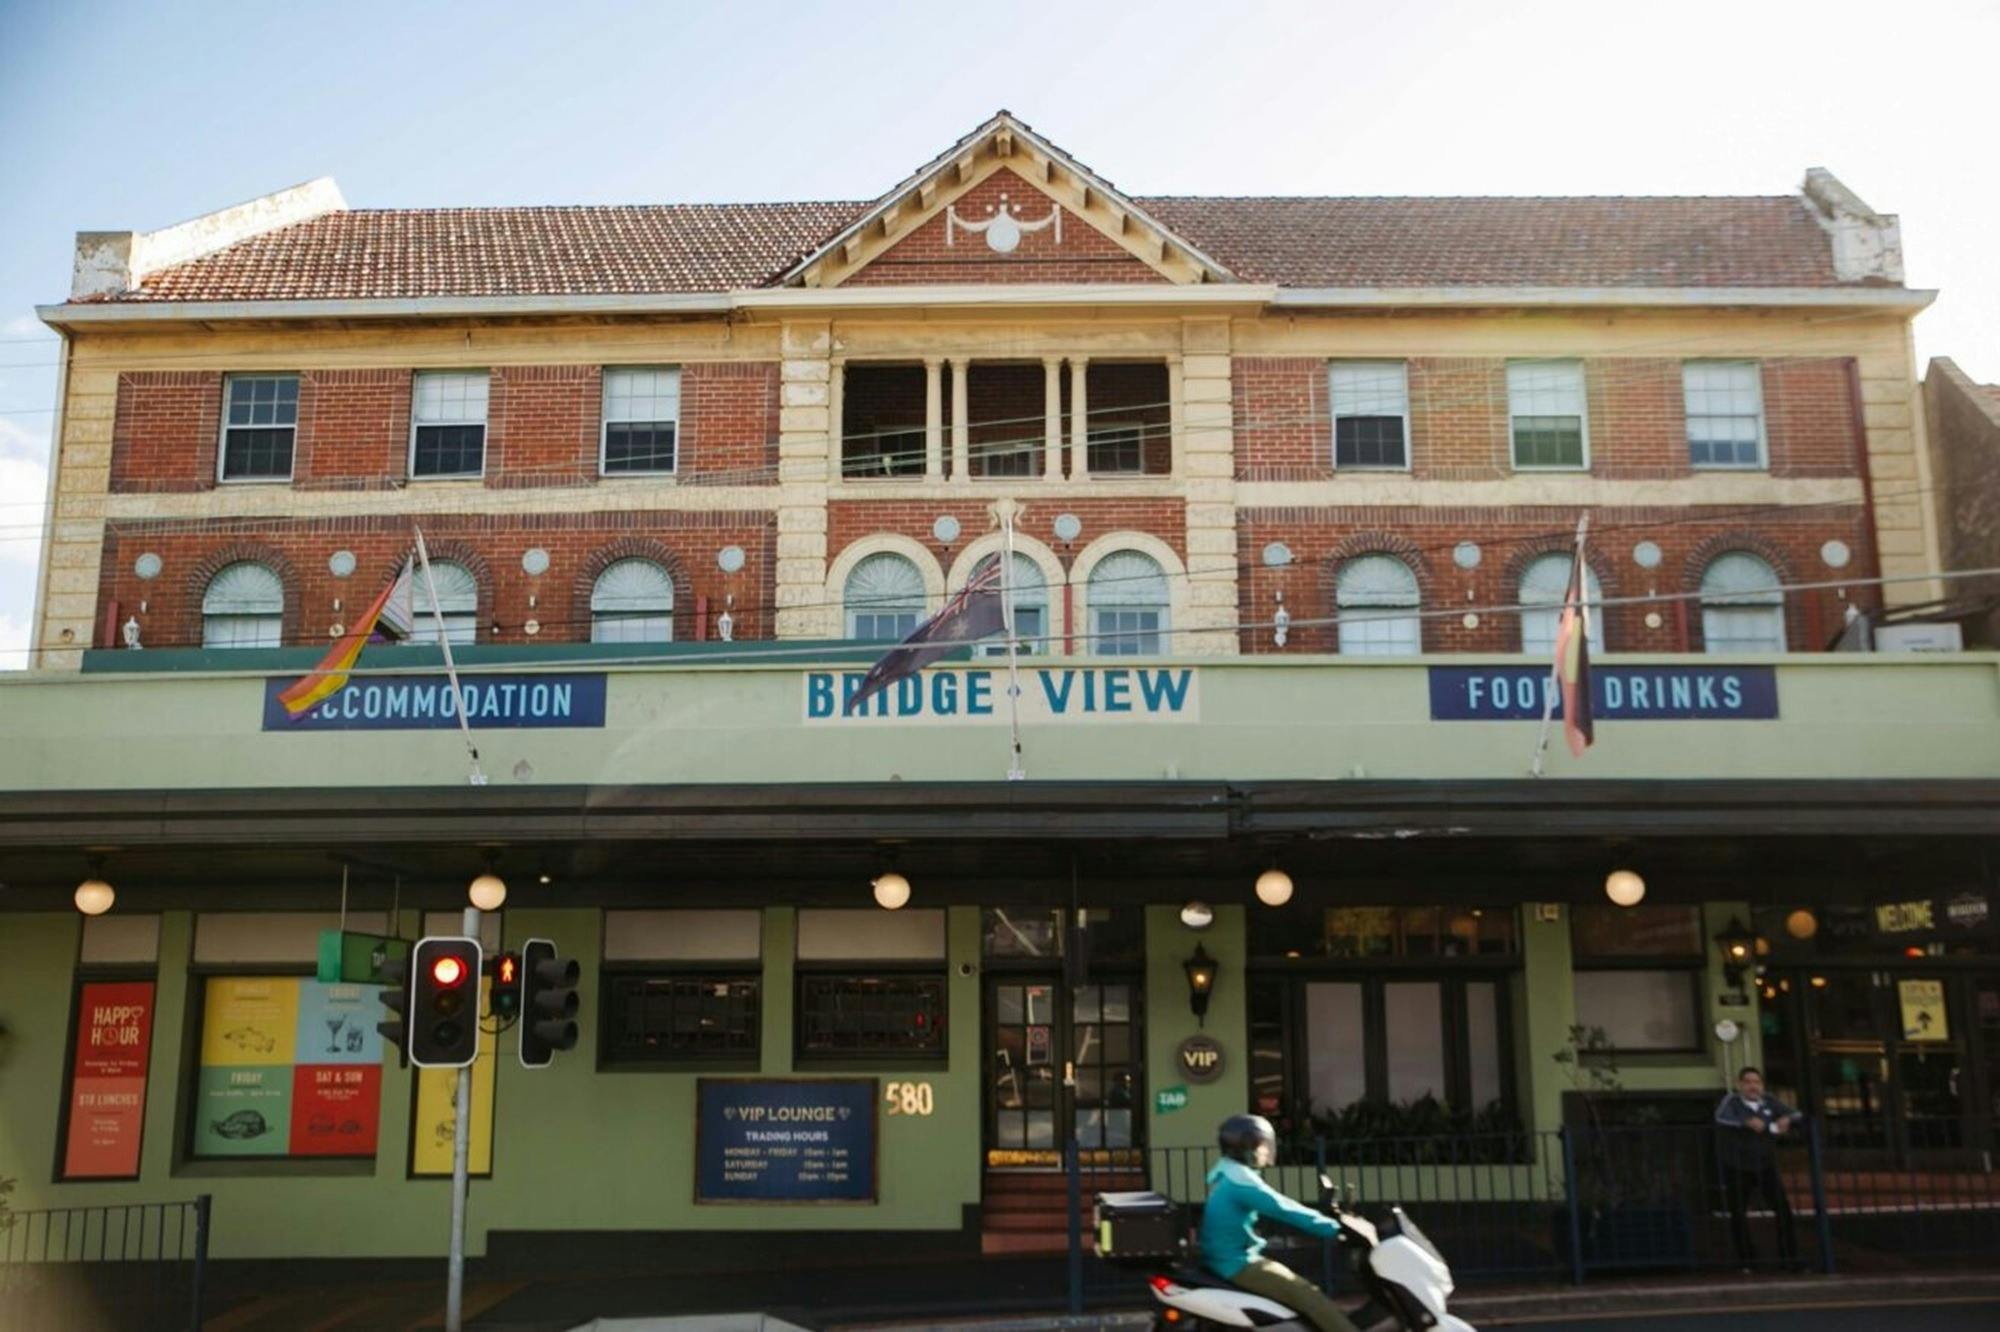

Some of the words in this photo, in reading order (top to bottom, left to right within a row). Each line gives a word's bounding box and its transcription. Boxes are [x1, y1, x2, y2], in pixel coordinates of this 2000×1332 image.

[311, 683, 572, 719] COMMODATION
[808, 670, 993, 718] BRIDGE
[1037, 669, 1193, 714] VIEW
[1468, 676, 1561, 709] FOOD
[1605, 675, 1743, 709] DRINKS
[1876, 901, 1936, 932] WELCOME
[1184, 1051, 1219, 1067] VIP
[315, 1071, 332, 1084] SAT
[344, 1071, 364, 1084] SUN
[739, 1106, 765, 1121] VIP
[768, 1106, 836, 1121] LOUNGE
[886, 1081, 934, 1116] 580
[745, 1131, 791, 1142] TRADING
[793, 1131, 829, 1142] HOURS
